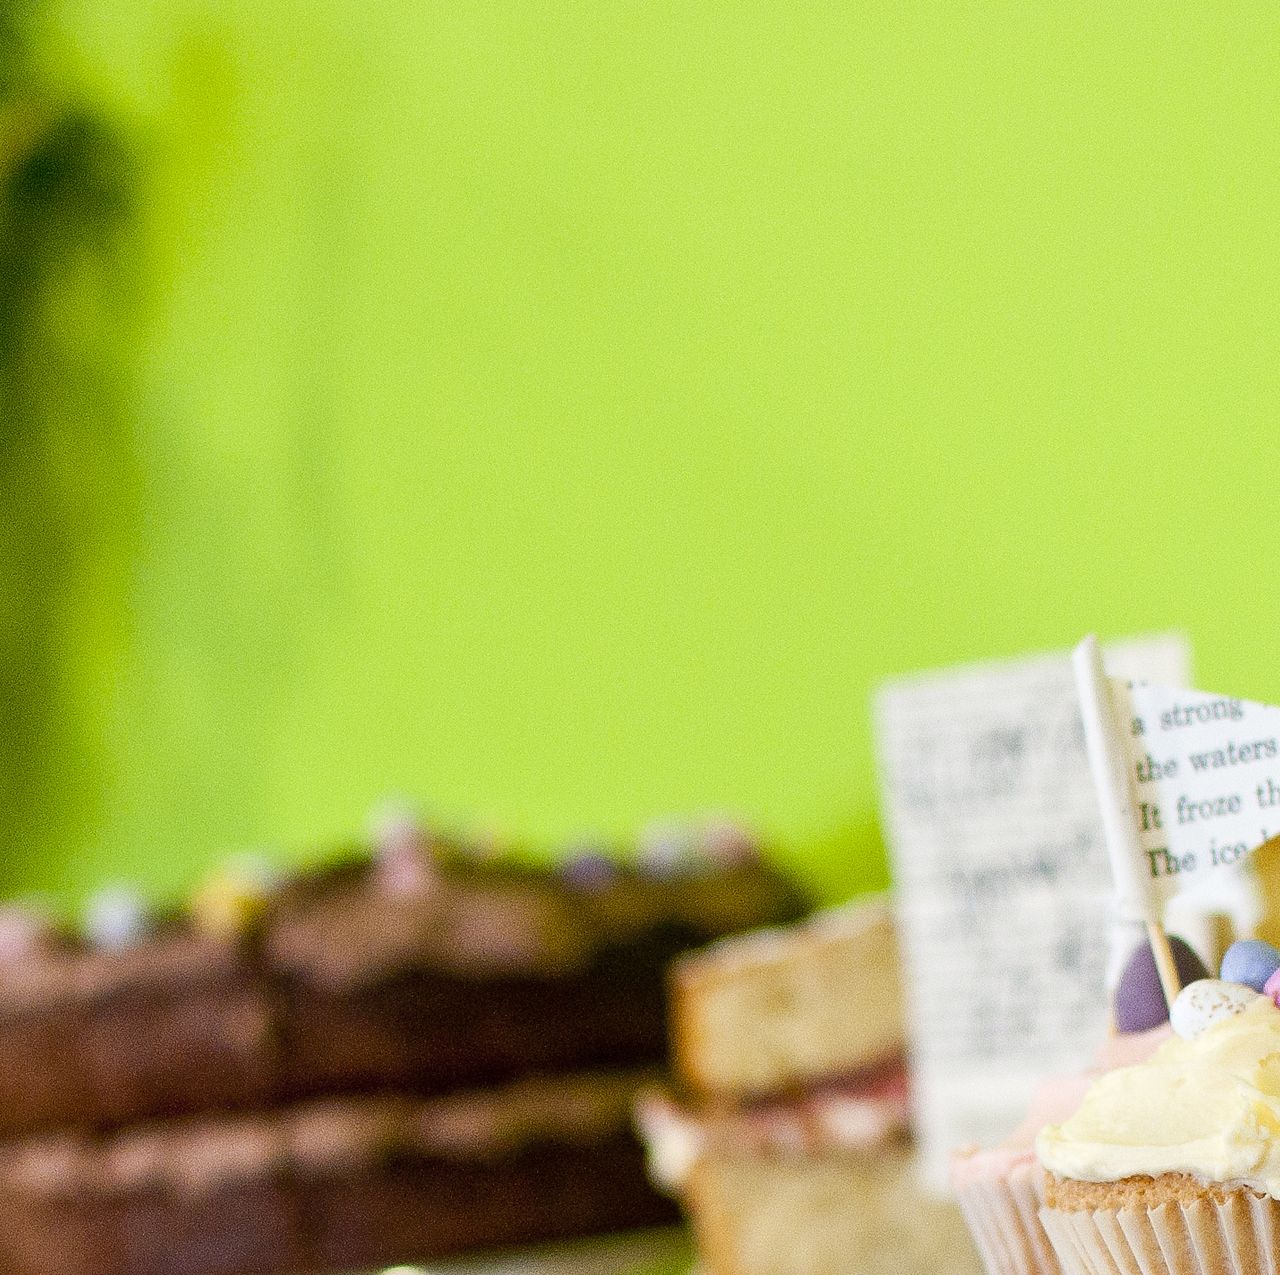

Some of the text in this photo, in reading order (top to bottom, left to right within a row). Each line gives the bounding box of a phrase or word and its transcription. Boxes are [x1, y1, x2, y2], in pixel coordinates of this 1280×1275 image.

[1160, 698, 1244, 730] strong
[1136, 753, 1177, 783] the
[1189, 735, 1277, 770] waters
[1139, 802, 1163, 830] It
[1177, 793, 1241, 825] froze
[1145, 837, 1248, 878] The ice
